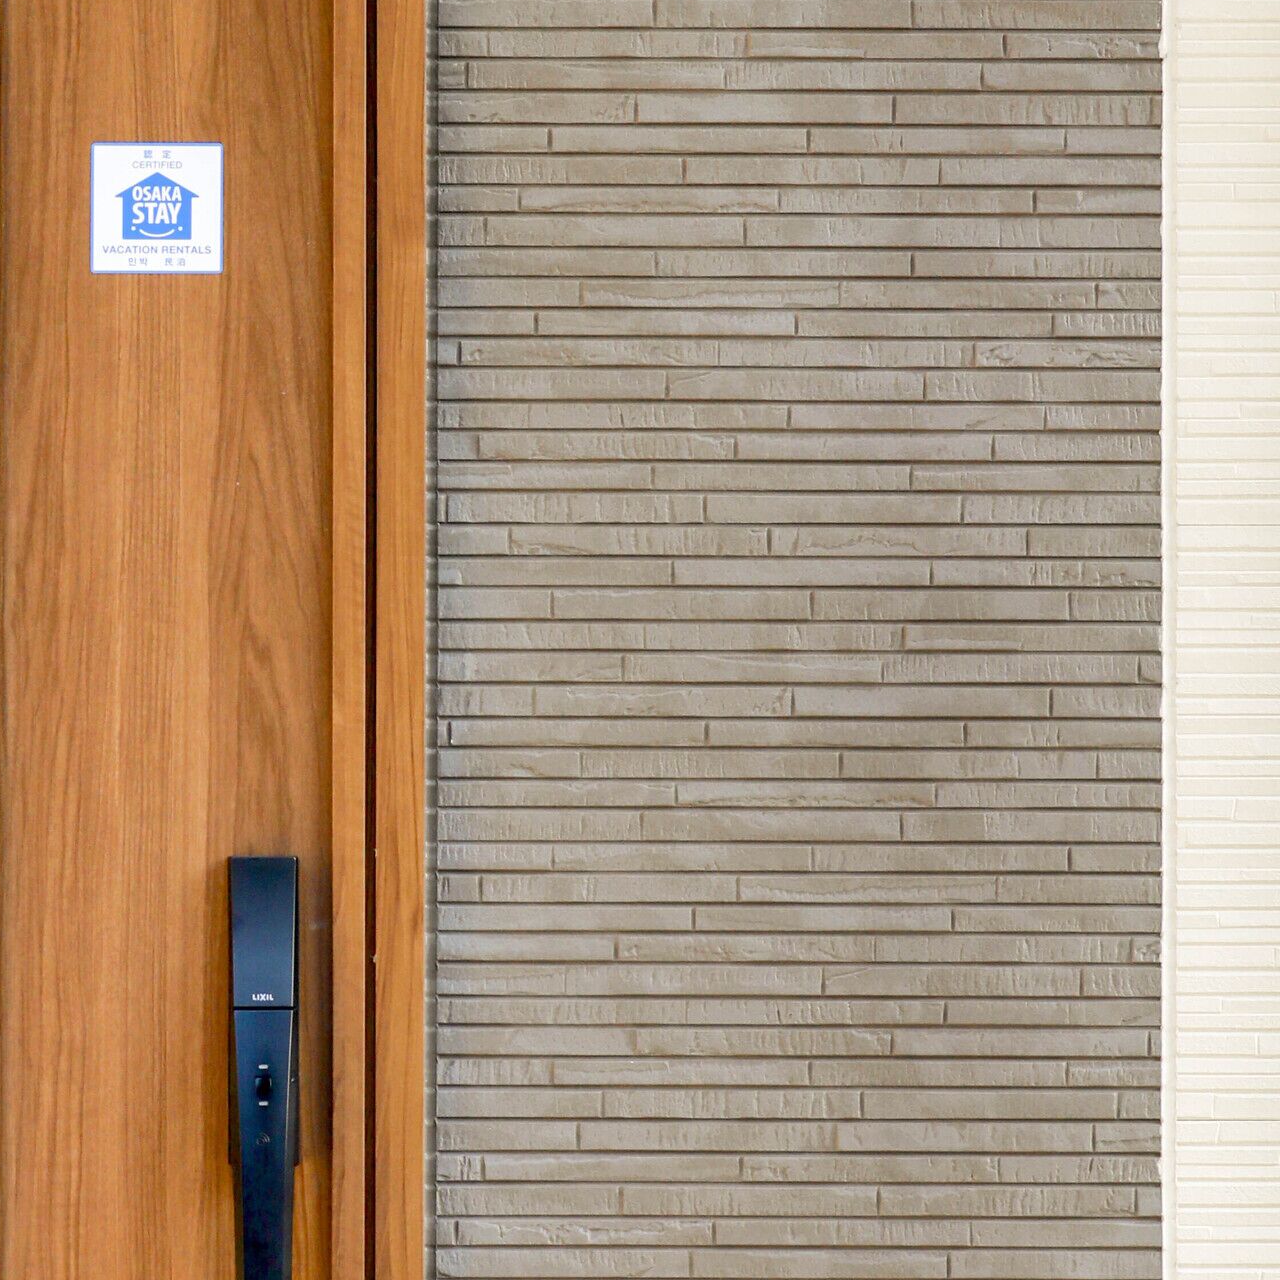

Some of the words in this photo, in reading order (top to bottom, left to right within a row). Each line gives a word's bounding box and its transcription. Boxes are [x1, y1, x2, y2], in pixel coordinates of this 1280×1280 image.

[132, 160, 183, 169] CERTIFIED
[132, 186, 182, 201] OSAKA
[132, 203, 182, 224] STAY
[102, 245, 158, 254] VACATION
[161, 245, 212, 254] RENTALS
[252, 993, 274, 1001] LIXIL
